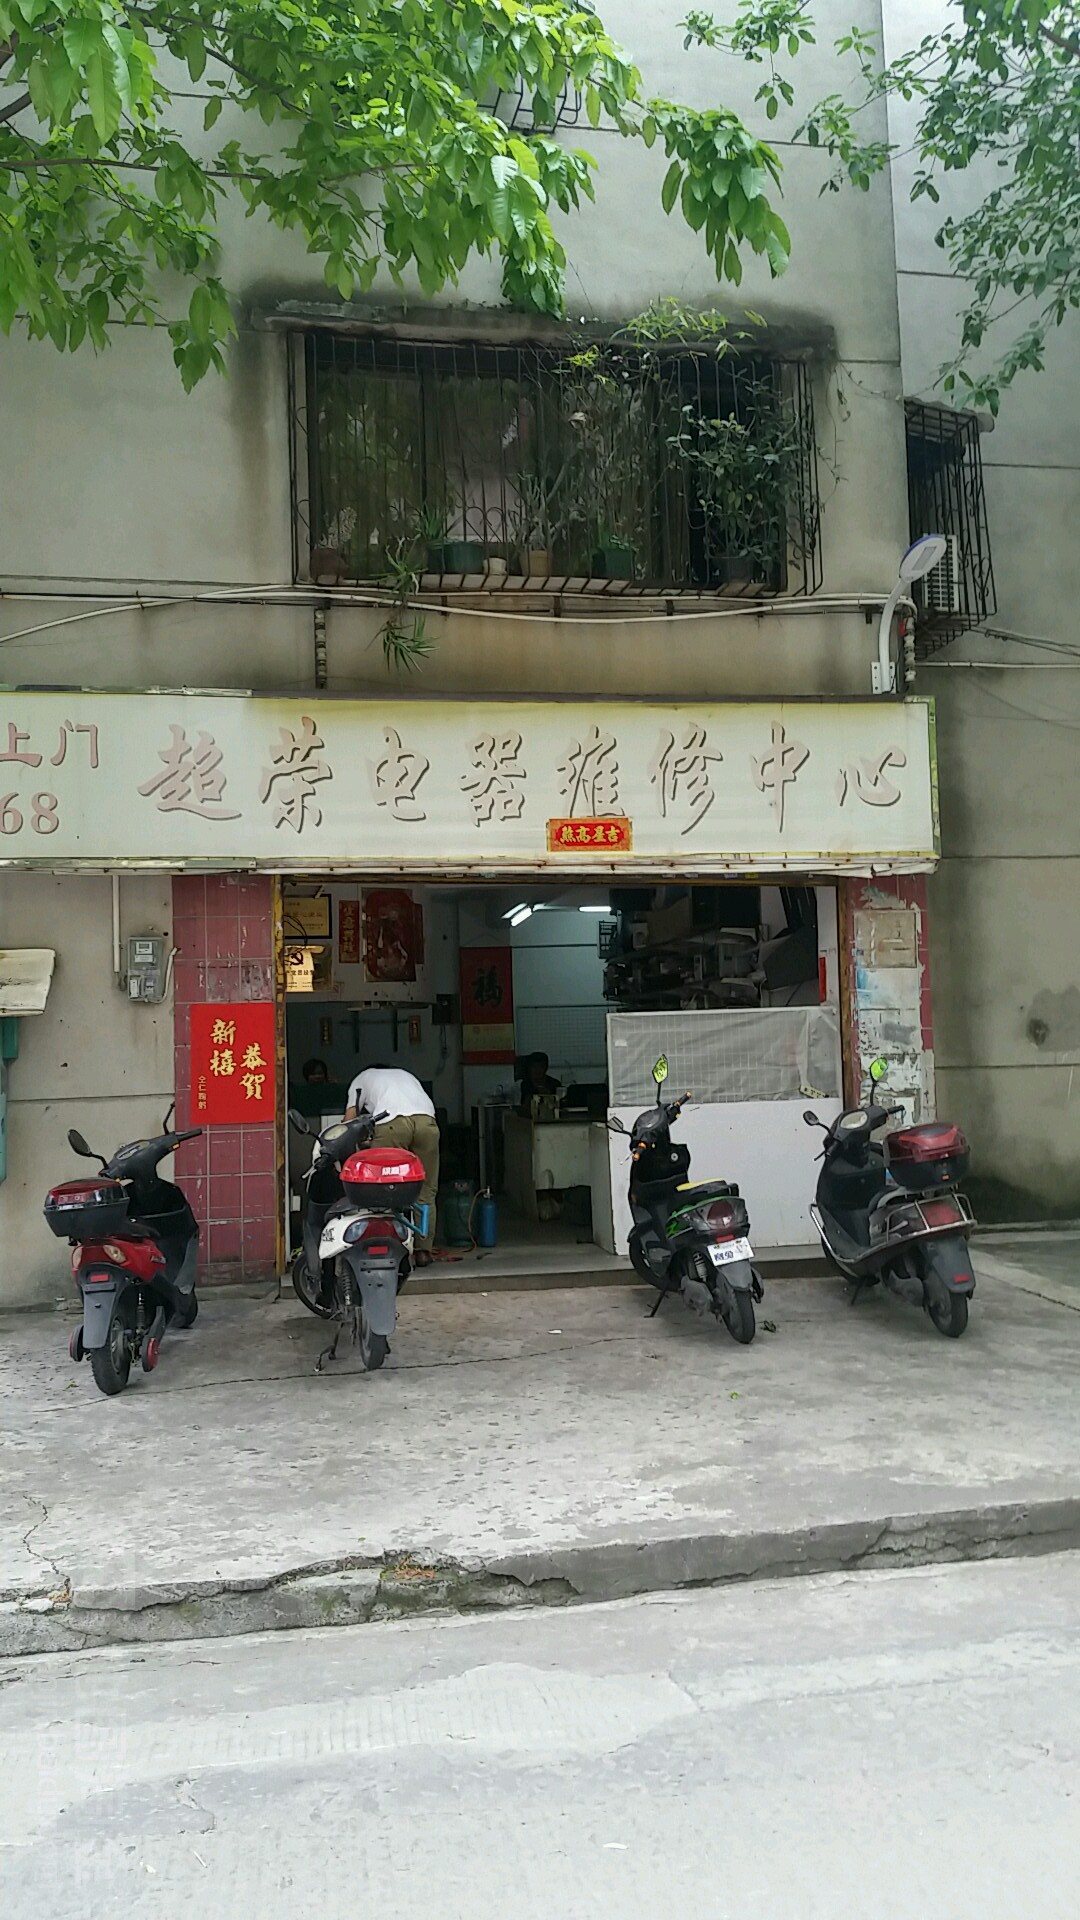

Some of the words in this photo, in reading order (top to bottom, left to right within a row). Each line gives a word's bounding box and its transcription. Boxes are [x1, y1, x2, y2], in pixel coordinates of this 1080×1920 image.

[0, 718, 99, 769] 上门
[136, 715, 907, 836] 超荣电器维修中心
[209, 1018, 237, 1077] 新禧
